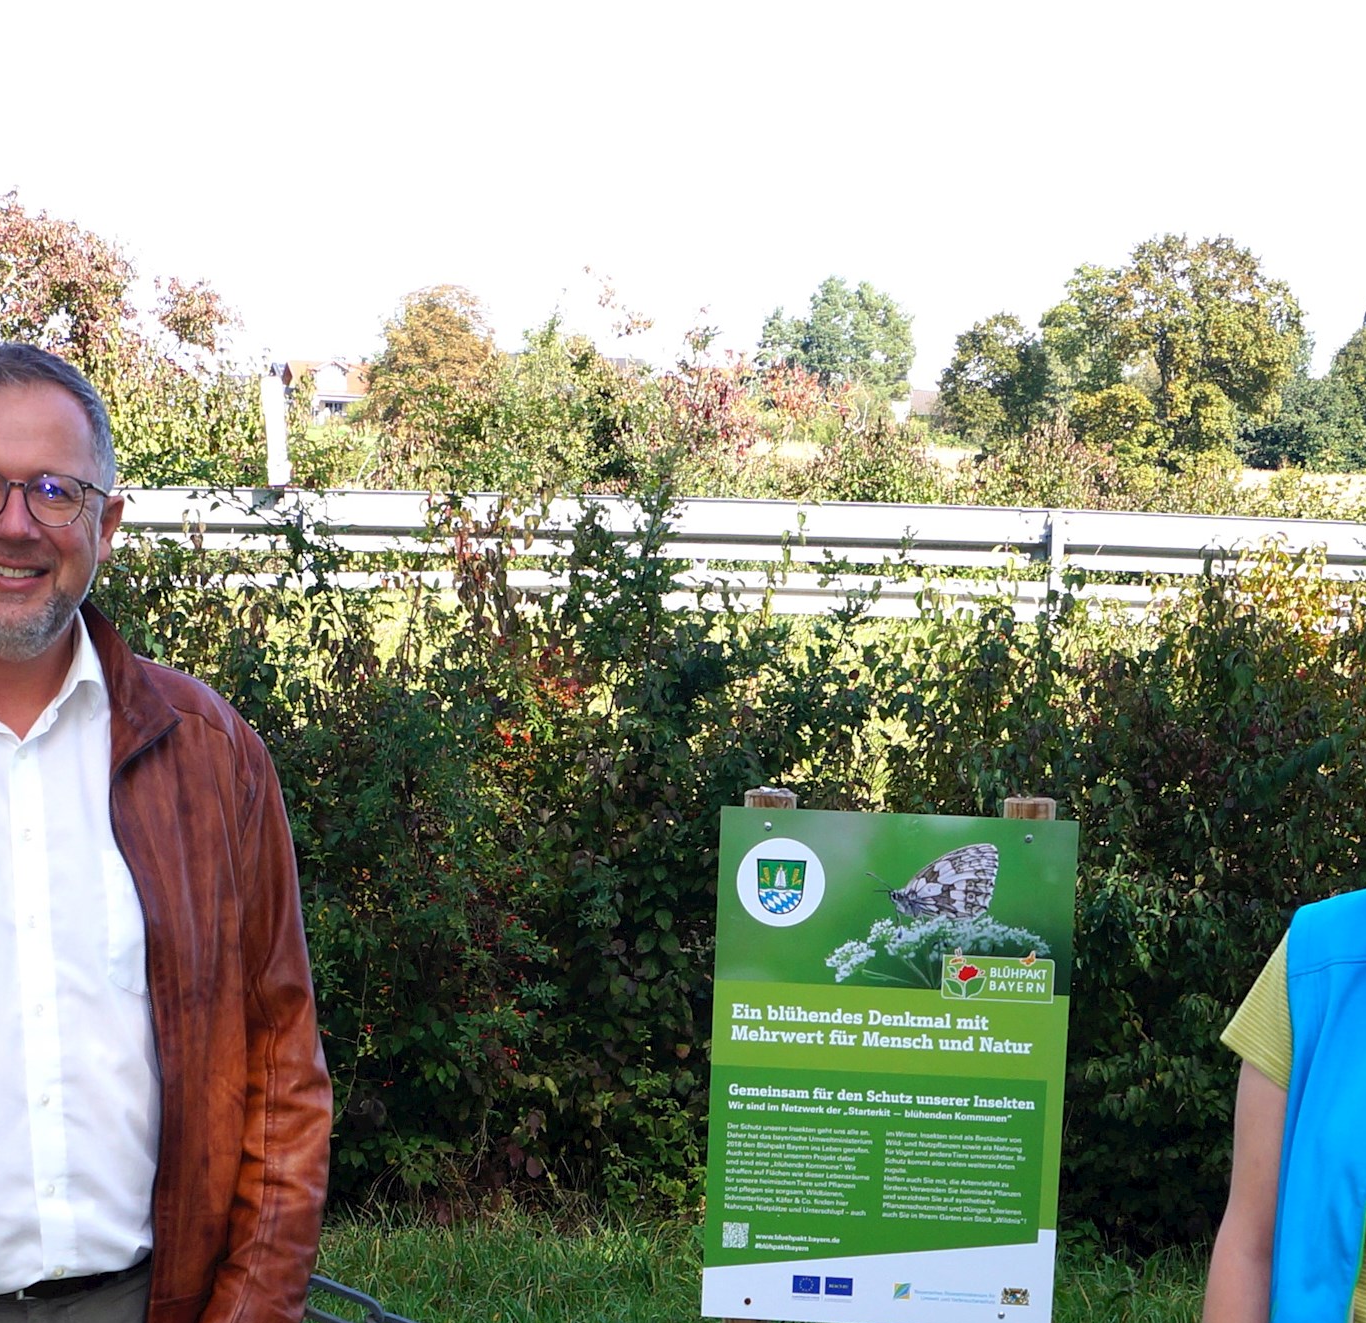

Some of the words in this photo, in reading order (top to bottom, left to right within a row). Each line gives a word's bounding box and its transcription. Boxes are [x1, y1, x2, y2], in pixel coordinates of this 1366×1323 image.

[990, 966, 1047, 980] BLÜHPAKT
[989, 980, 1046, 993] BAYERN
[732, 1004, 762, 1020] Ein
[767, 1005, 863, 1024] blühendes
[868, 1010, 951, 1028] Denkmal
[956, 1014, 989, 1030] mit
[731, 1025, 824, 1044] Mehrwert
[829, 1030, 857, 1046] für
[862, 1031, 933, 1049] Mensch
[939, 1036, 974, 1051] und
[979, 1036, 1033, 1054] Natur
[729, 1084, 809, 1099] Gemeinsam
[813, 1087, 834, 1100] für
[837, 1088, 863, 1101] den
[866, 1090, 912, 1104] Schutz
[916, 1095, 970, 1107] unserer
[973, 1095, 1035, 1110] Insekten
[728, 1101, 744, 1110] Wir
[746, 1102, 765, 1111] sind
[767, 1103, 779, 1111] im
[781, 1103, 824, 1114] Netzwerk
[826, 1106, 841, 1114] der
[843, 1107, 891, 1117] „Starterkit
[904, 1110, 952, 1120] blühenden
